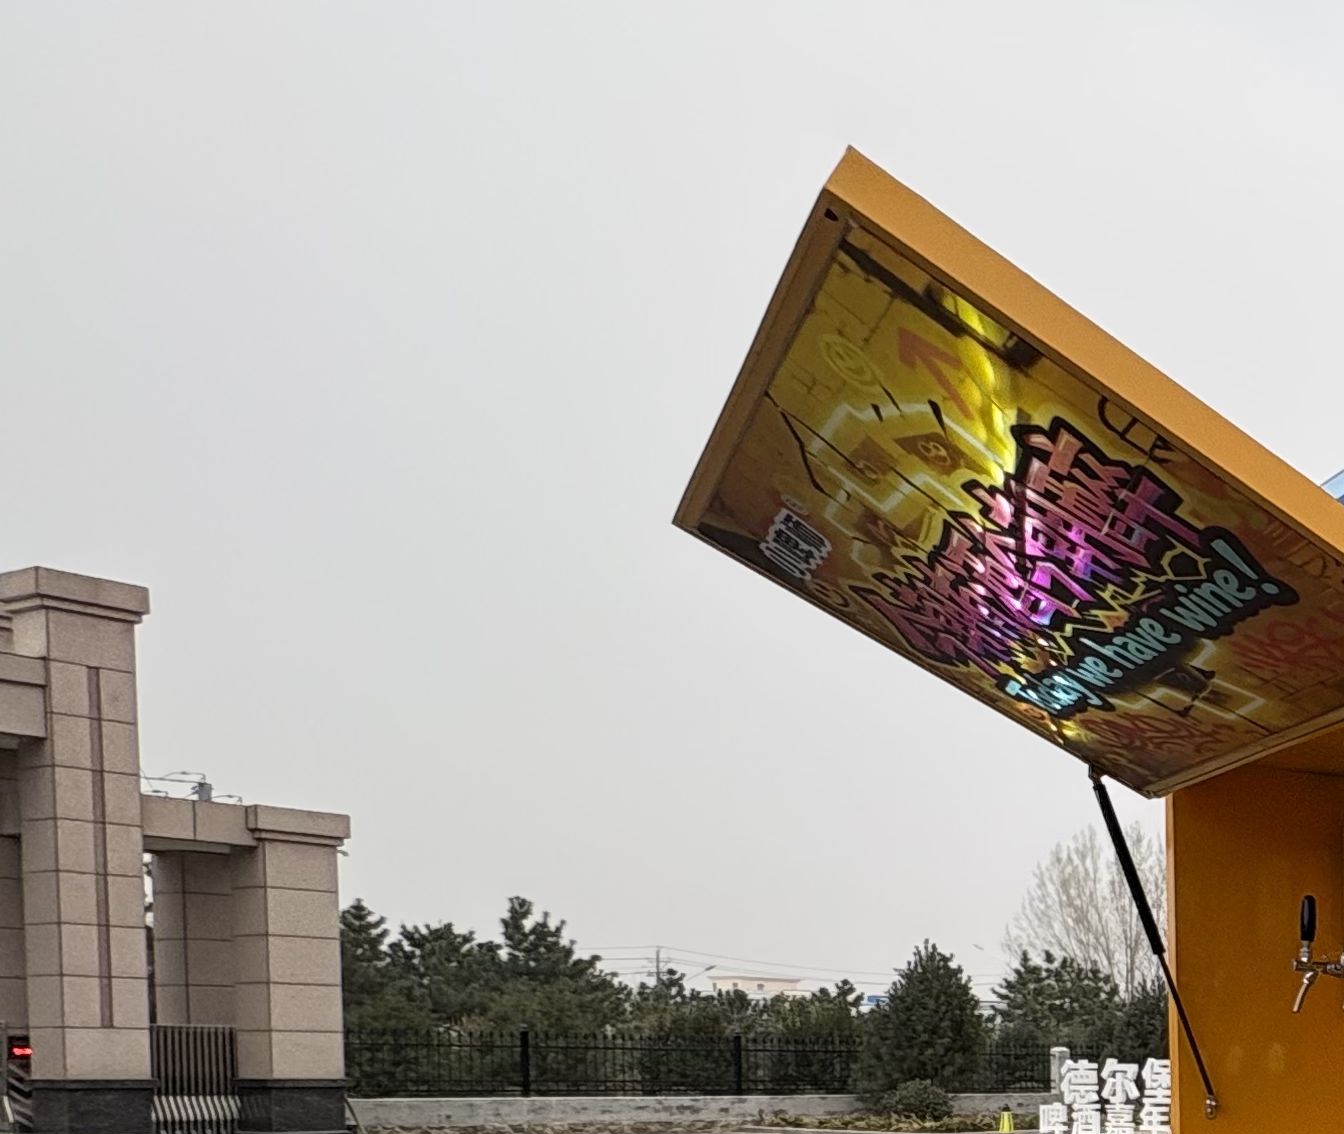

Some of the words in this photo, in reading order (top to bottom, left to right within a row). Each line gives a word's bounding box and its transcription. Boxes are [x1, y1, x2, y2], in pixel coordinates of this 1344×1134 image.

[853, 425, 1202, 682] 今朝有酒今朝醉
[1160, 539, 1280, 632] wine!
[1079, 618, 1182, 669] have
[1005, 671, 1103, 715] Today
[1066, 656, 1123, 687] we
[1060, 1057, 1171, 1105] 德尔堡
